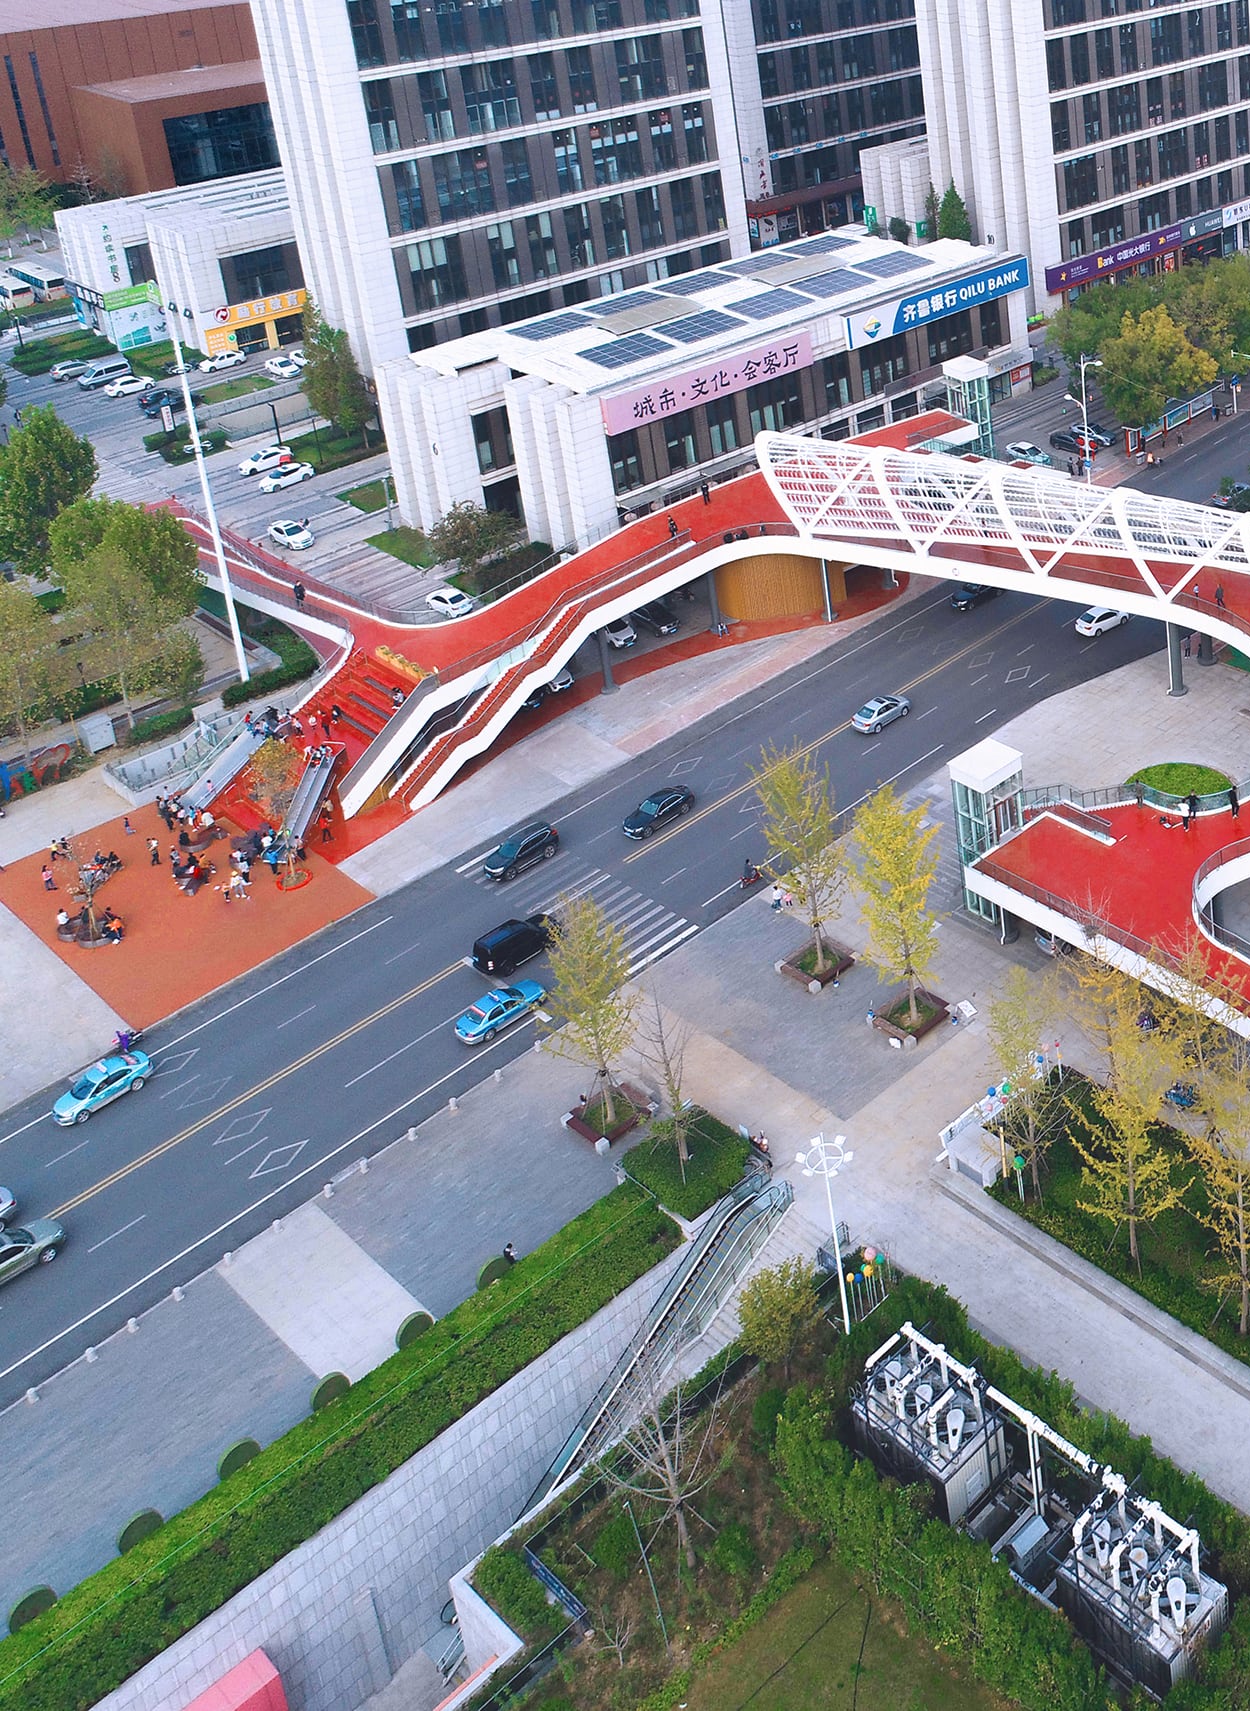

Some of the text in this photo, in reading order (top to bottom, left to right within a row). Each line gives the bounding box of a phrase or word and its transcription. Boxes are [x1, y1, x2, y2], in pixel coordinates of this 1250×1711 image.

[1097, 241, 1151, 269] Bank 中国光大银行
[903, 269, 1020, 323] 齐鲁银行 QILU BANK
[633, 342, 799, 419] 城市·文化·会客厅
[432, 442, 439, 456] 6
